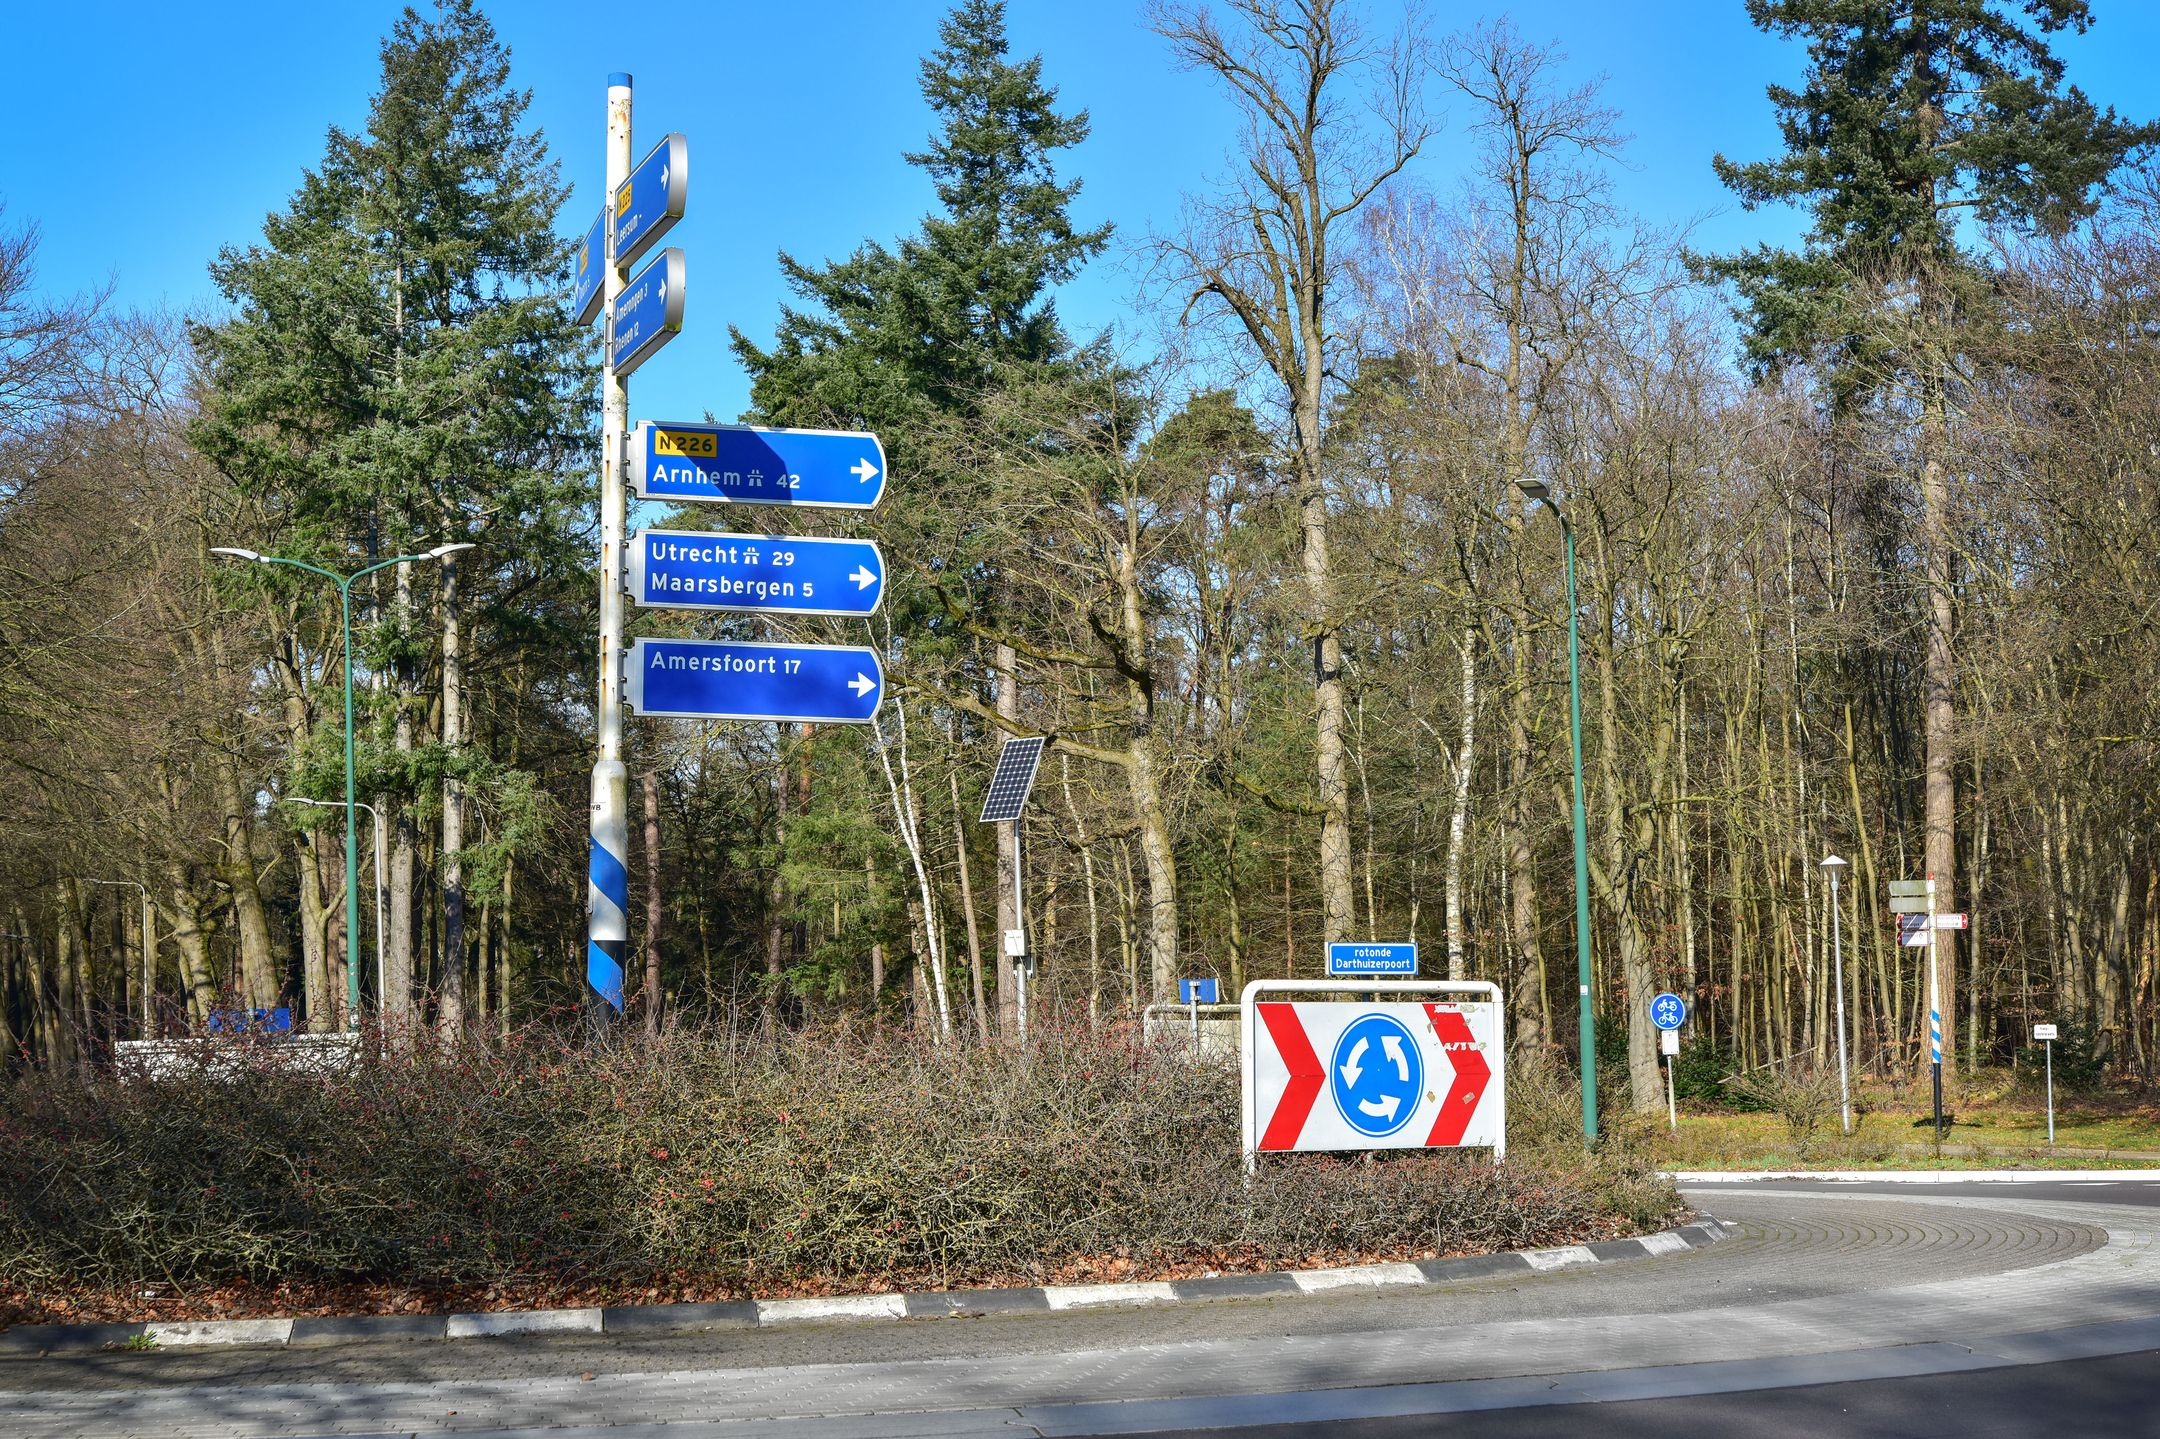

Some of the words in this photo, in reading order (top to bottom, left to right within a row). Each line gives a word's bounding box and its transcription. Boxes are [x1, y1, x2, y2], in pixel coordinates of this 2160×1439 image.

[659, 431, 713, 452] N226
[652, 463, 741, 487] Arnhem
[776, 474, 801, 490] 42
[651, 542, 738, 564] Utrecht
[772, 551, 796, 567] 29
[651, 572, 794, 601] Maarsbergen
[802, 582, 814, 598] 5
[650, 650, 776, 674] Amersfoort
[784, 659, 801, 675] 17
[1335, 957, 1410, 970] Darthuizerpoort
[1354, 947, 1392, 957] rotonde
